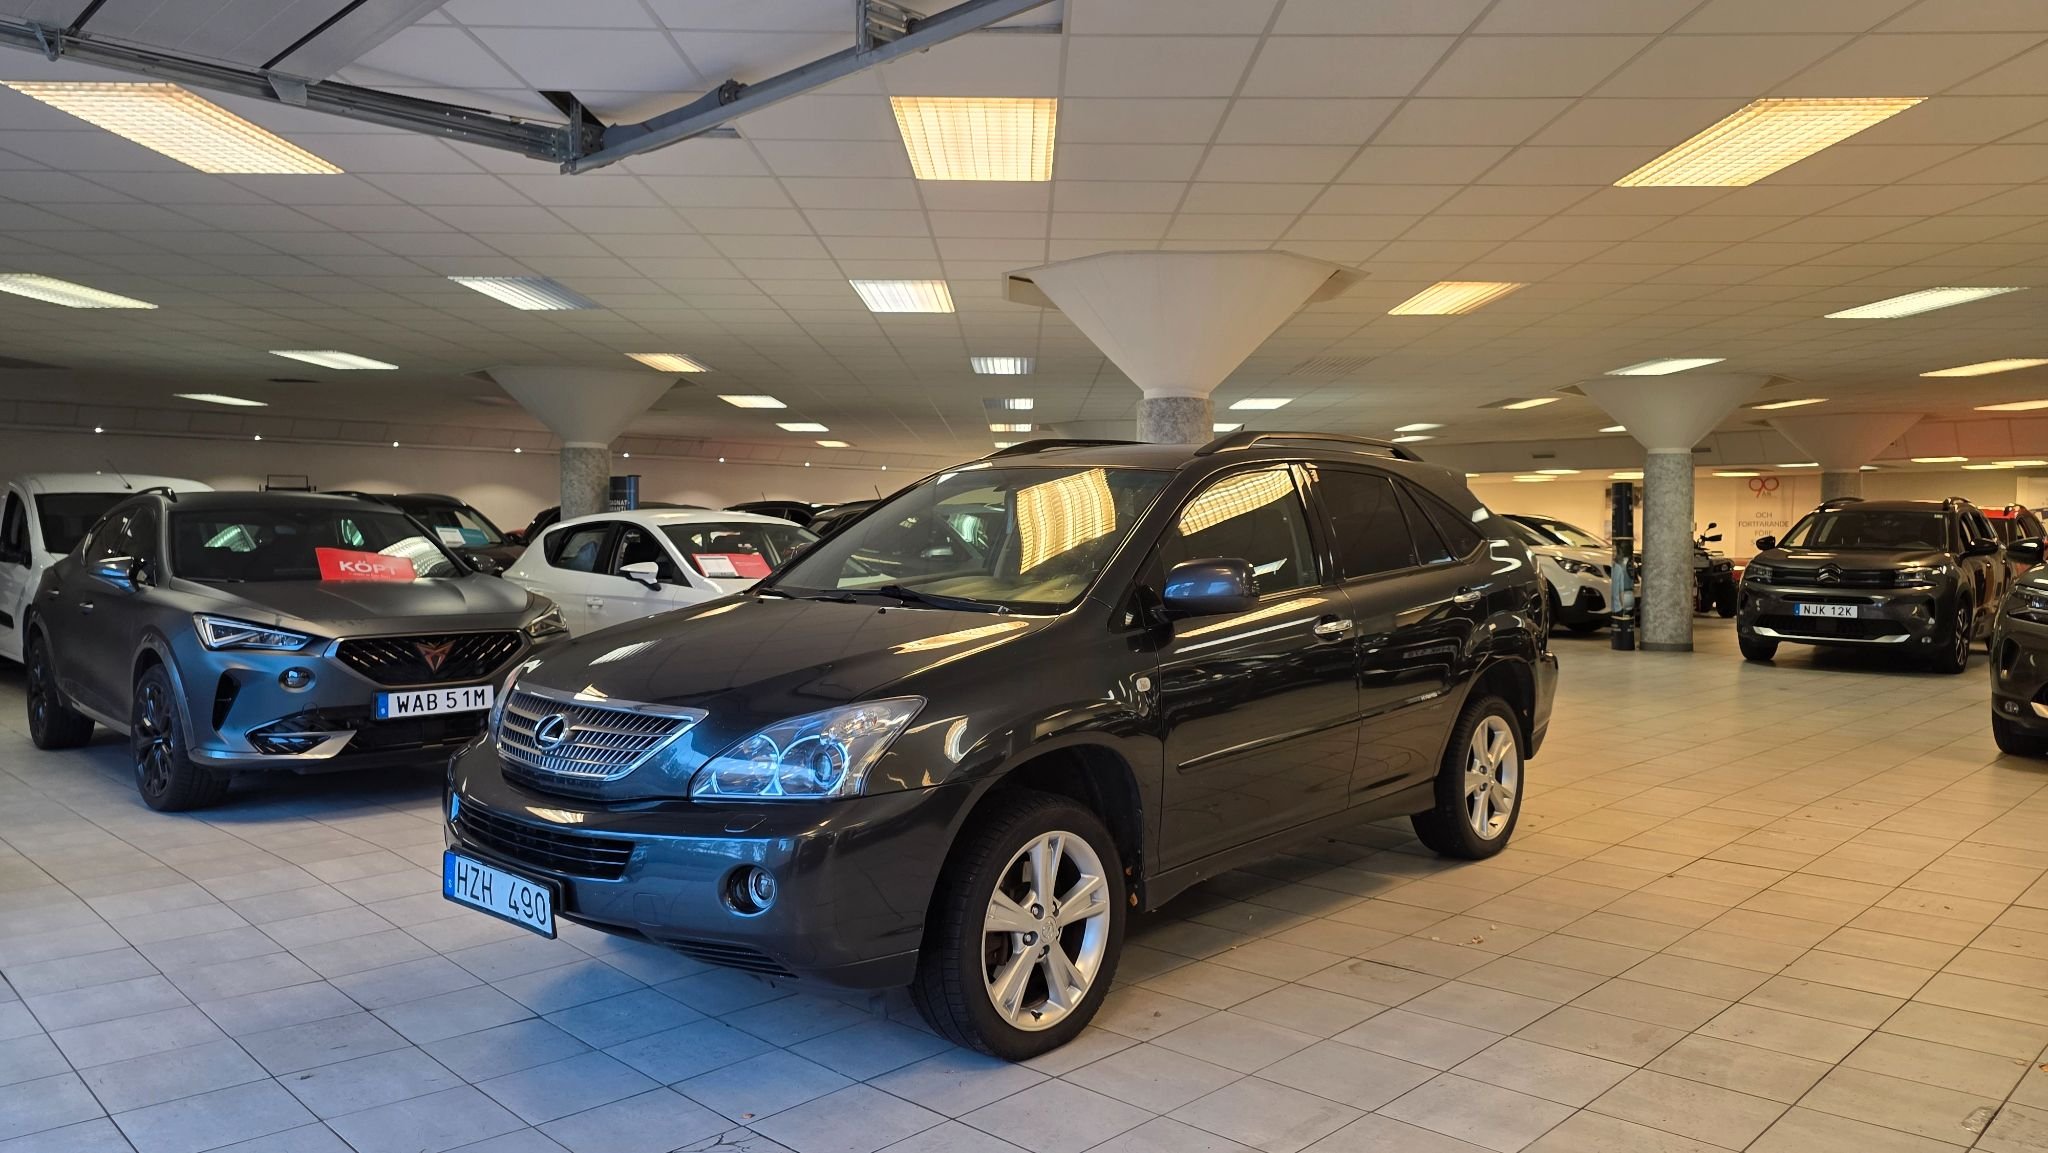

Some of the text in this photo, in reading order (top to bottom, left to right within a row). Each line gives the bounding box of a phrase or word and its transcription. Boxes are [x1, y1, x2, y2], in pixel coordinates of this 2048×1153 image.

[1755, 511, 1773, 519] OCH
[1803, 605, 1852, 616] NJK 12K
[396, 688, 485, 714] WAB 51M
[457, 862, 546, 925] HZH 490
